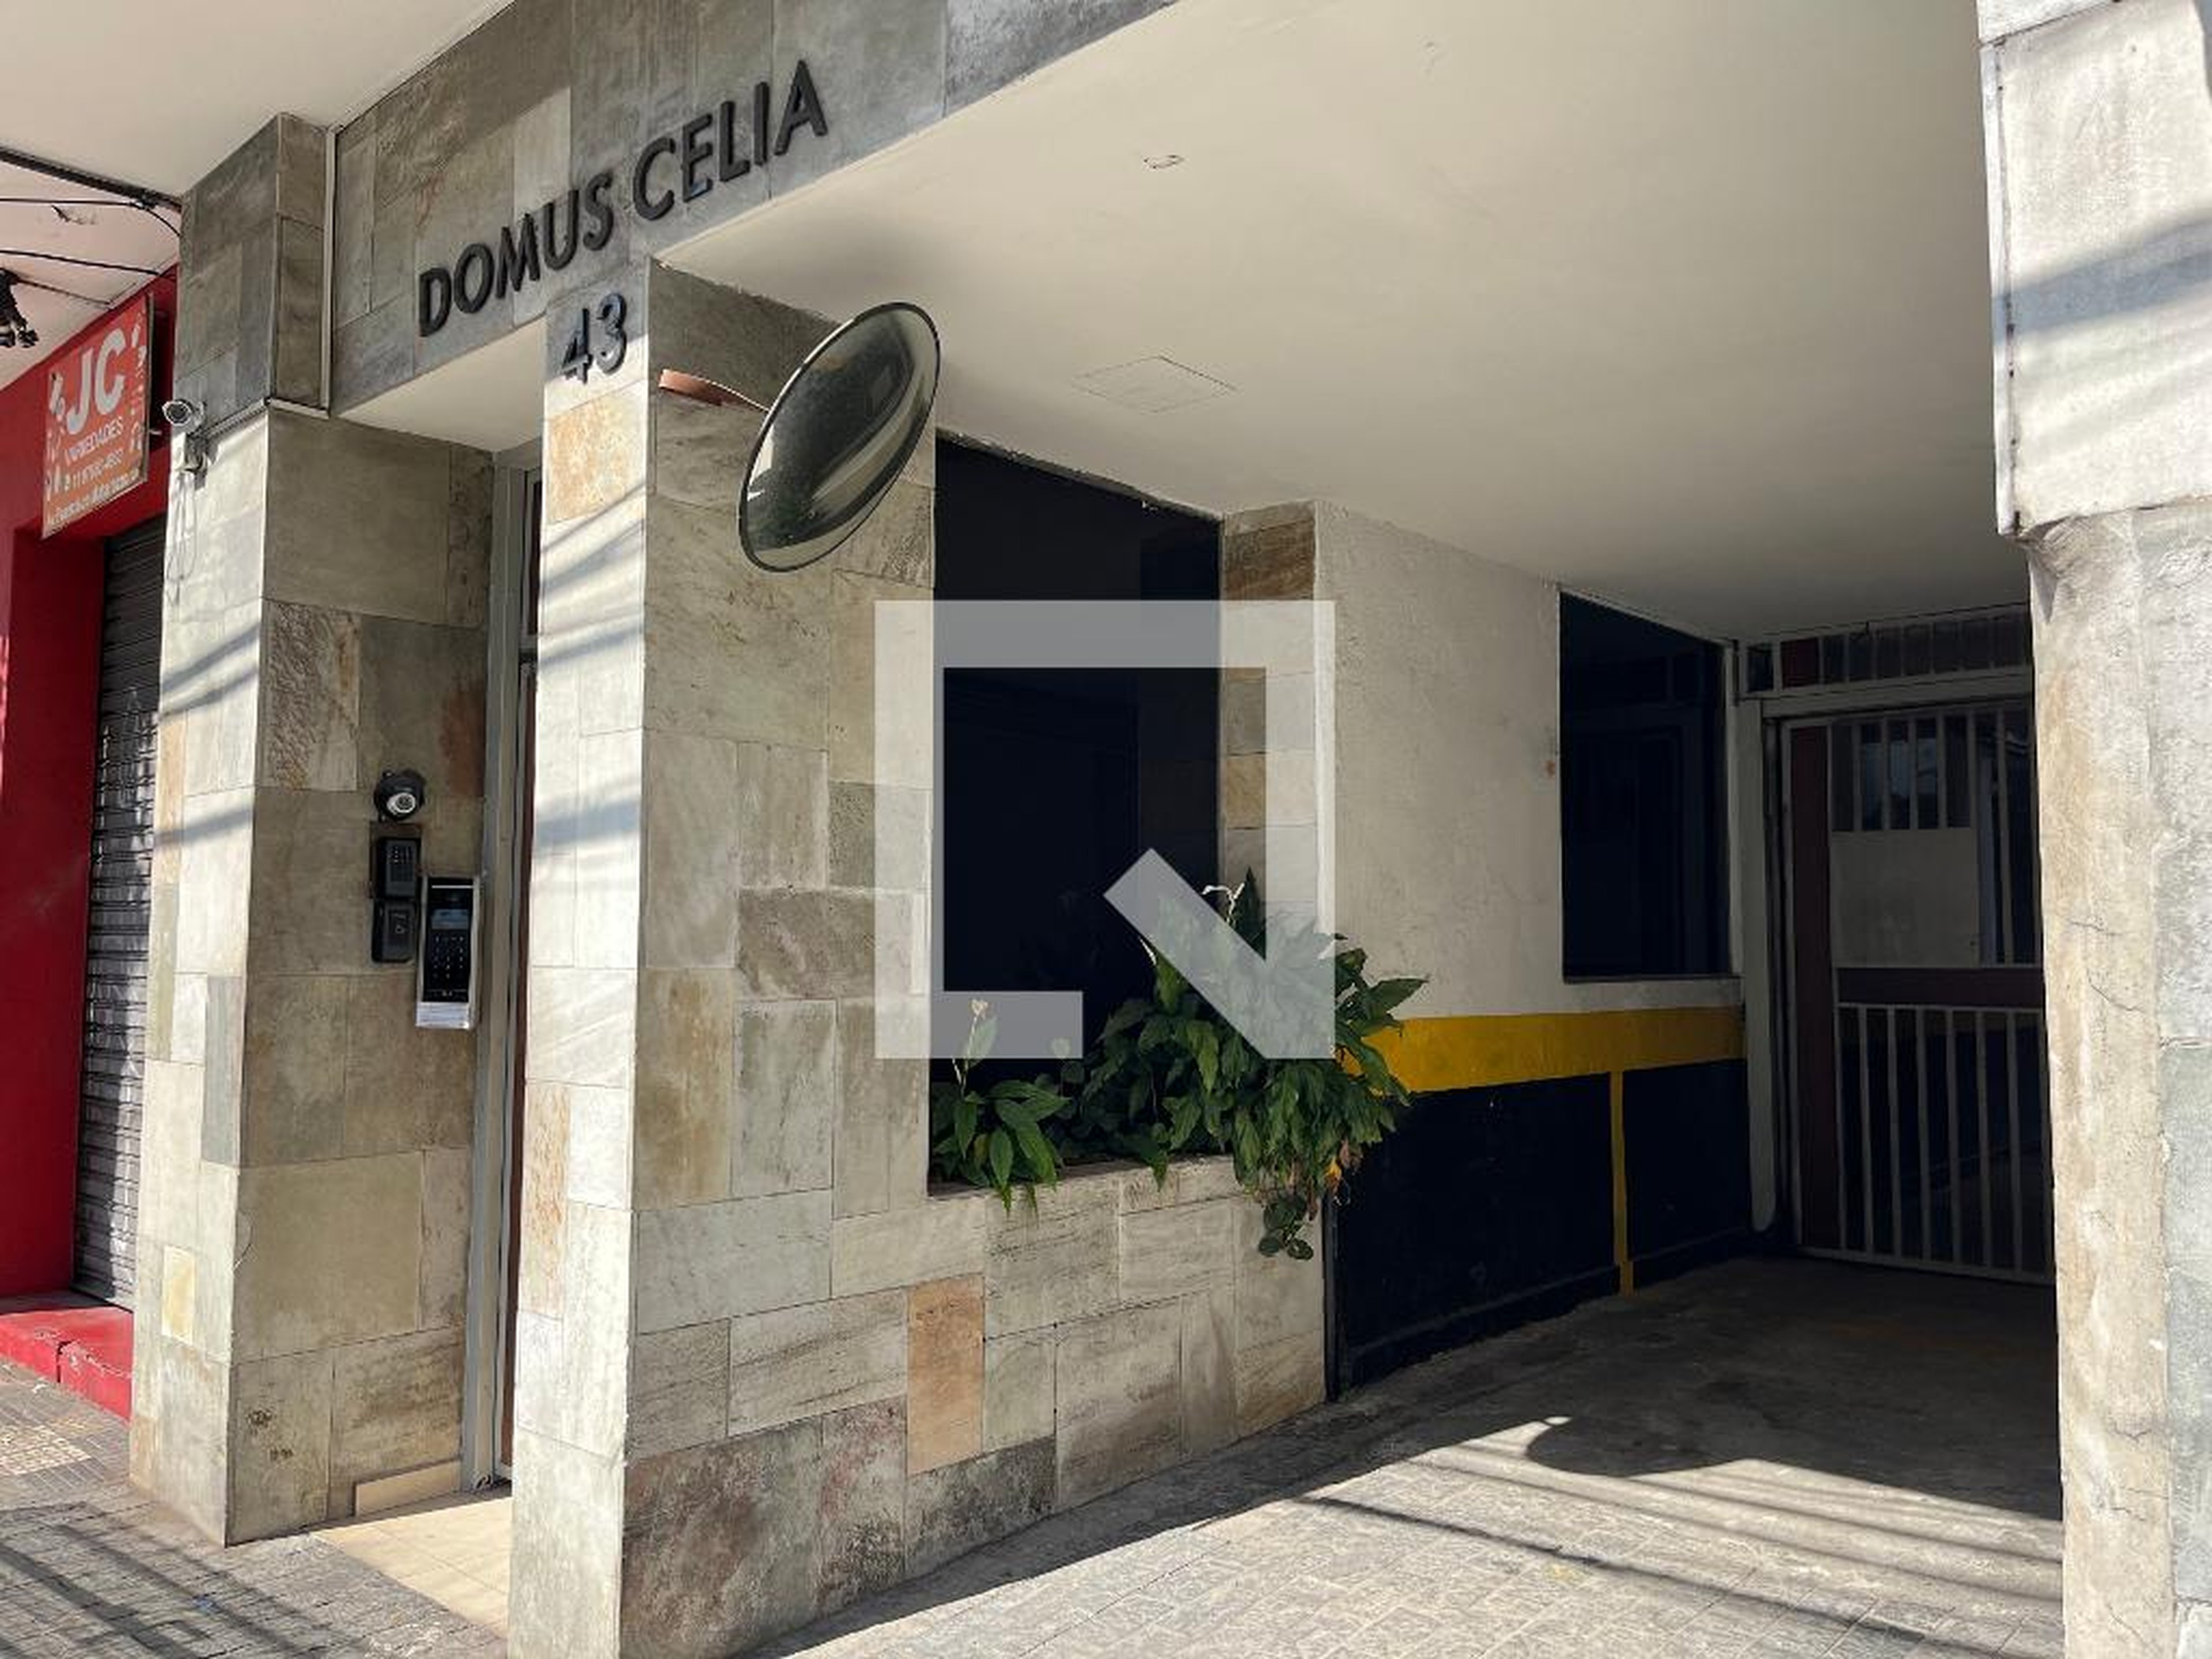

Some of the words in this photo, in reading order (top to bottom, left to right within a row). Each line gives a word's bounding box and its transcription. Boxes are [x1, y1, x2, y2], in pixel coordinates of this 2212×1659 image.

[419, 170, 614, 337] DOMUS
[632, 60, 828, 221] CELIA
[66, 328, 126, 434] JC
[560, 292, 627, 384] 43
